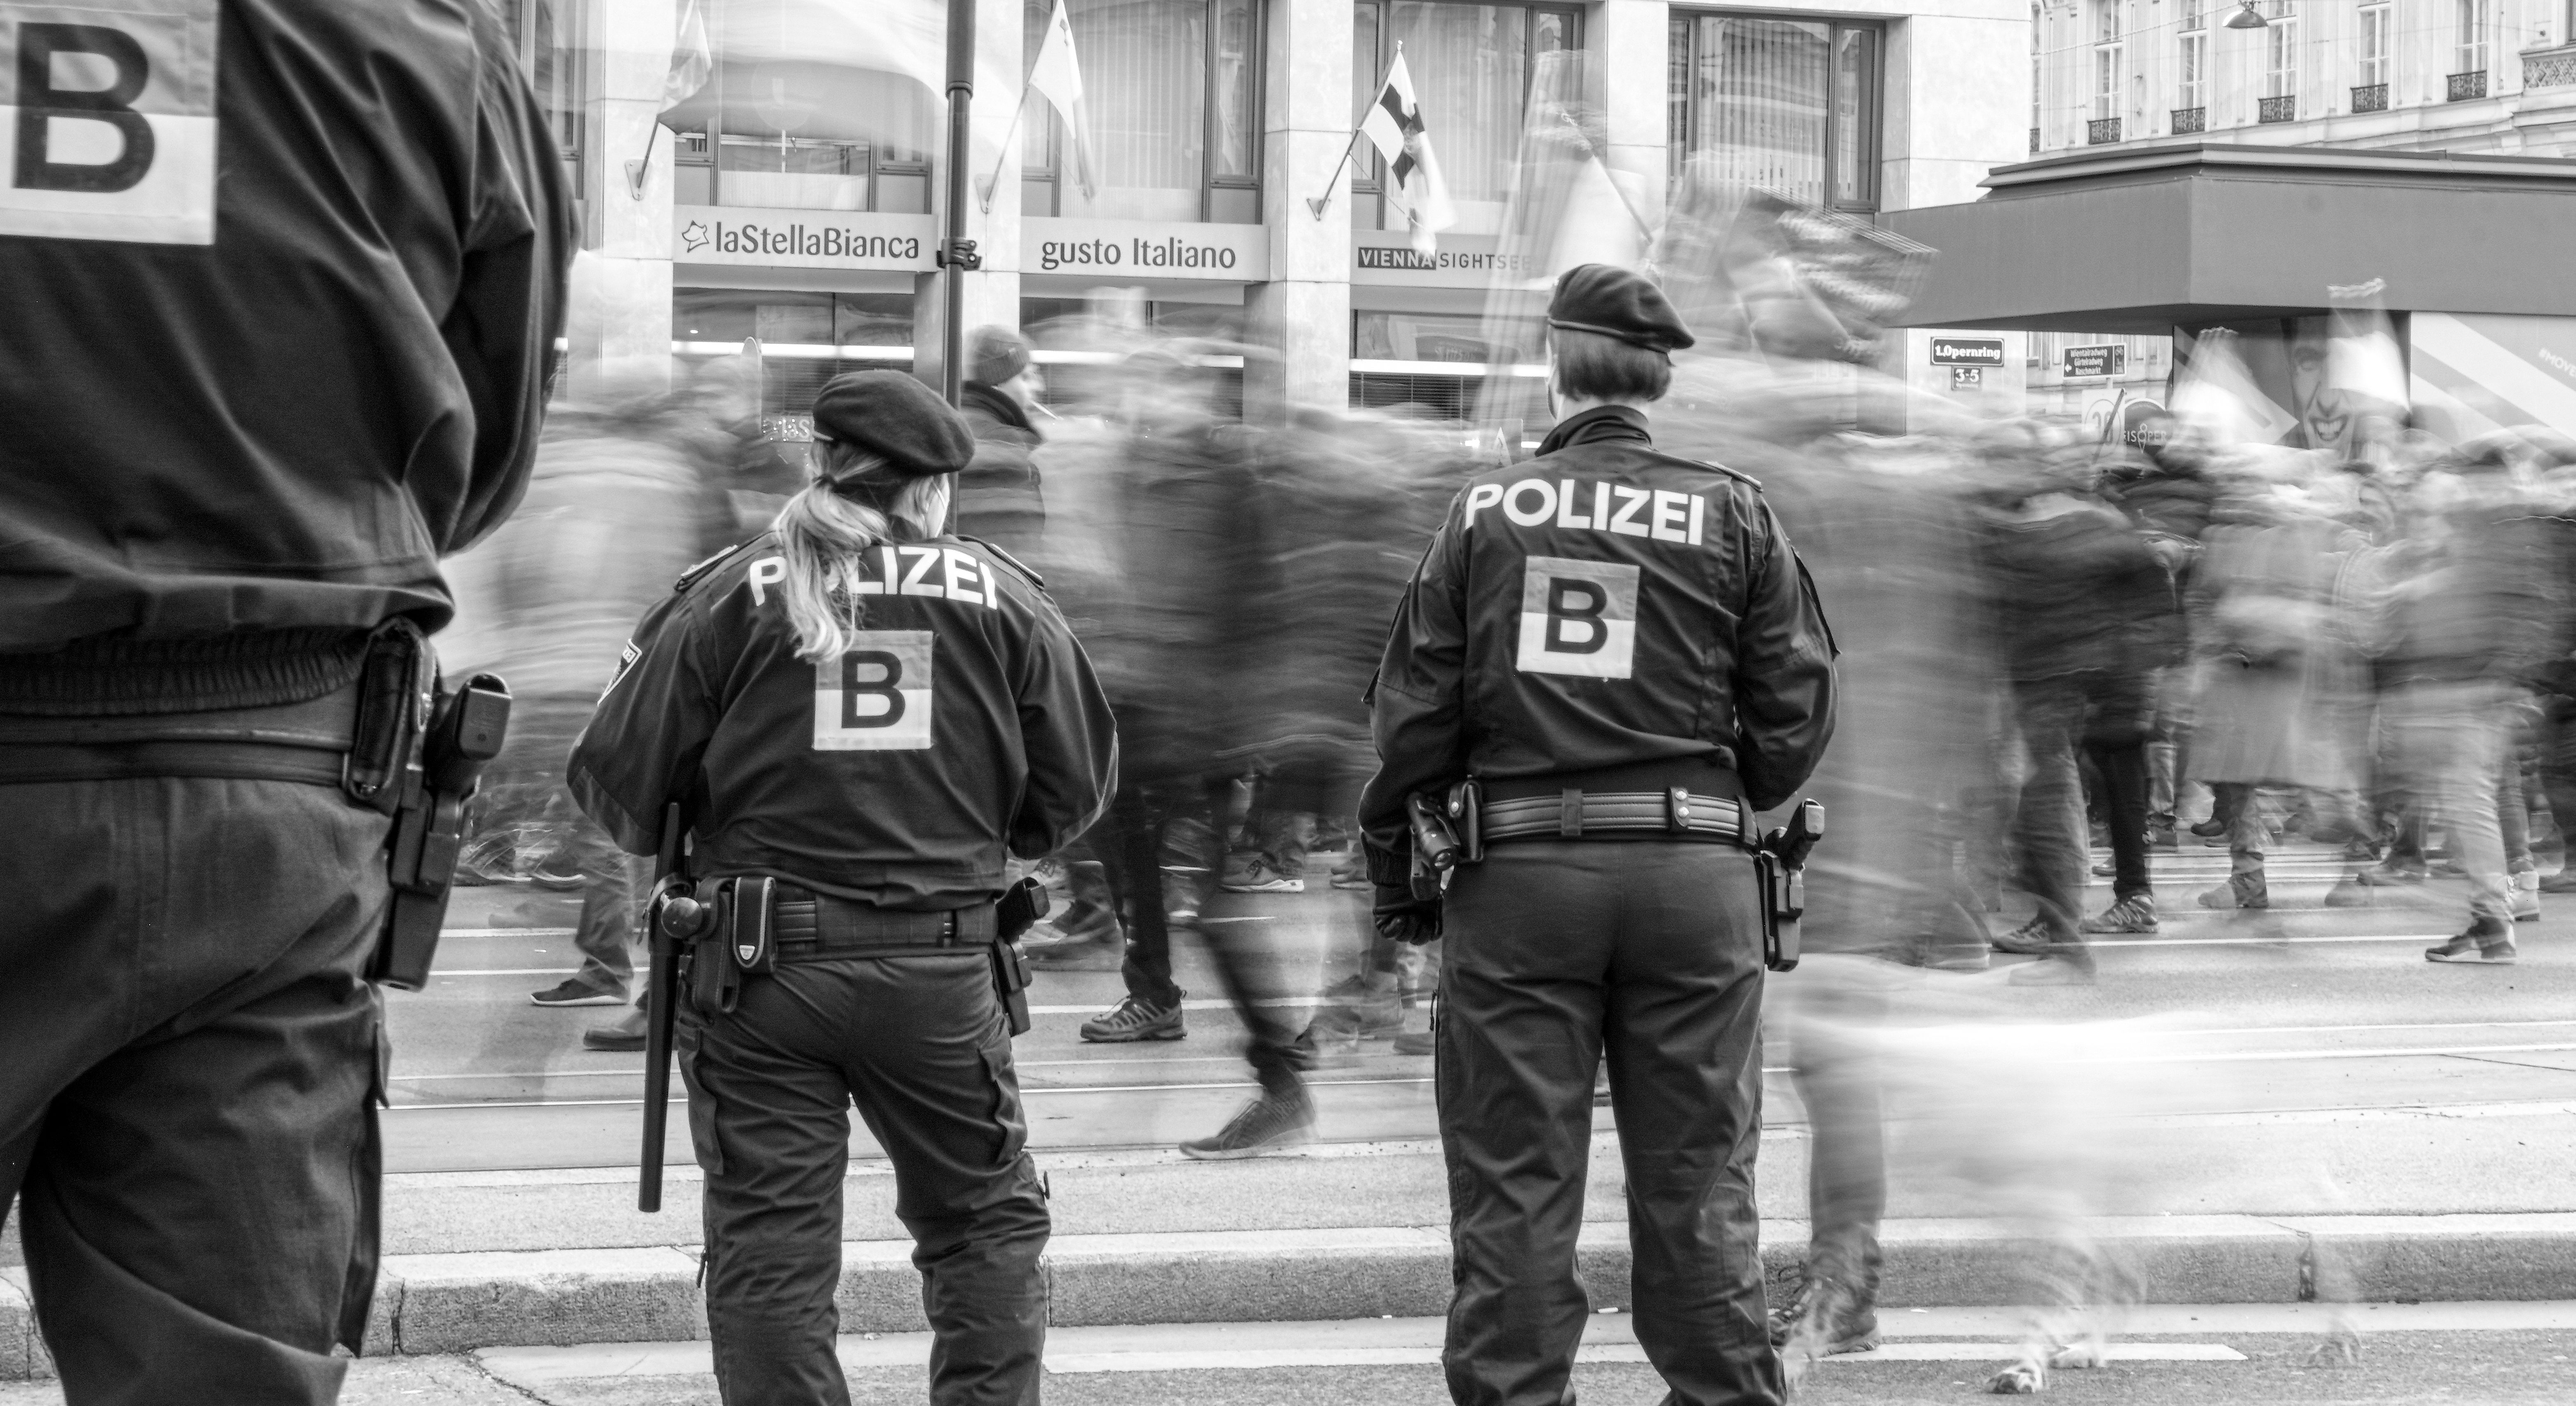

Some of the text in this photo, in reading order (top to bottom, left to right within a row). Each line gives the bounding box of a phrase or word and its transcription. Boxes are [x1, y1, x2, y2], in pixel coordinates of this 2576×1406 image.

[12, 21, 156, 193] B
[716, 221, 919, 259] laStellaBianca
[1041, 237, 1236, 270] gusto Italiano
[1361, 249, 1434, 268] VIENNA
[1955, 369, 1979, 383] 3-5
[1465, 478, 1704, 546] POLIZEI
[750, 546, 997, 610] PLIZEI
[1544, 577, 1609, 655] B
[841, 650, 906, 729] B
